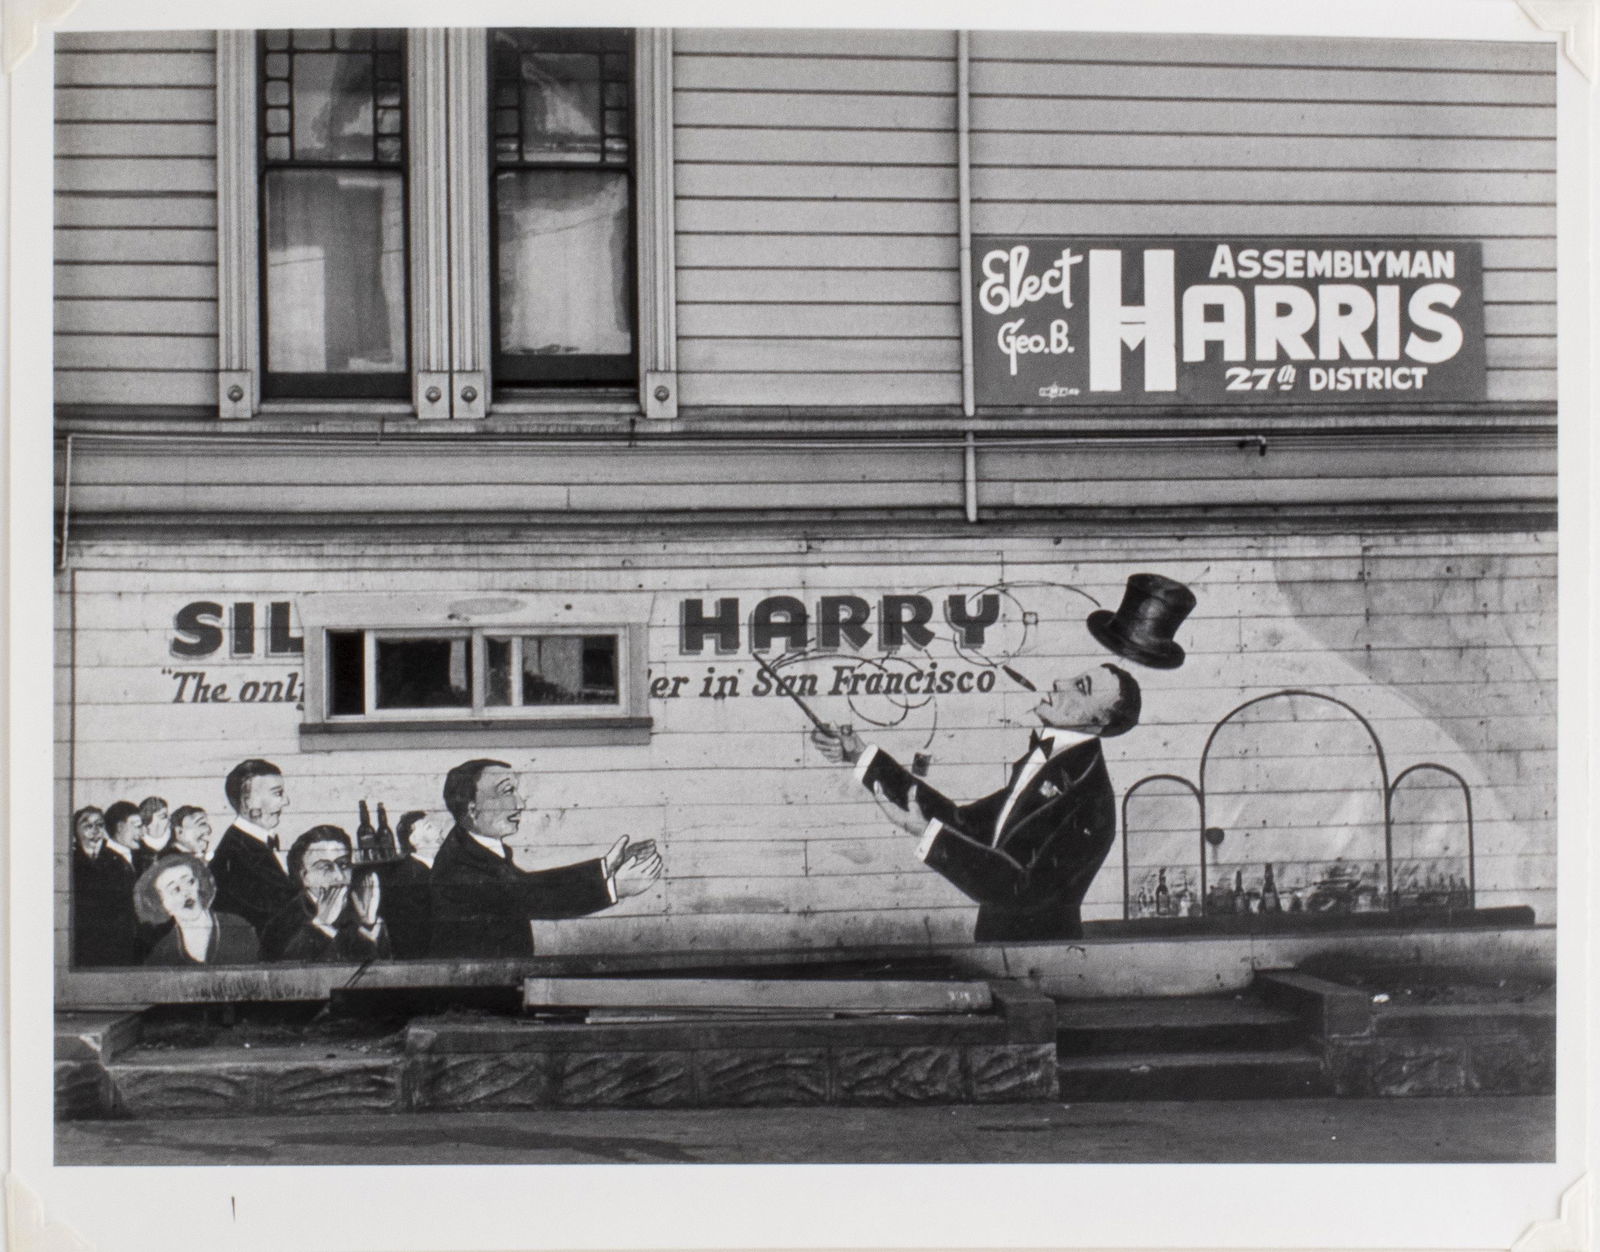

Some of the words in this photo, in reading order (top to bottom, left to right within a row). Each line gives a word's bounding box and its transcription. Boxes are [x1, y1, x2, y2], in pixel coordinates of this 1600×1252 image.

[979, 245, 1083, 314] Elect
[1209, 244, 1455, 279] ASSEMBLYMAN
[1088, 248, 1464, 393] HARRIS
[1309, 366, 1428, 391] DISTRICT
[679, 593, 1001, 655] HARRY
[648, 668, 690, 698] er
[699, 666, 740, 699] in
[752, 666, 818, 697] San
[828, 661, 996, 697] Francisco
